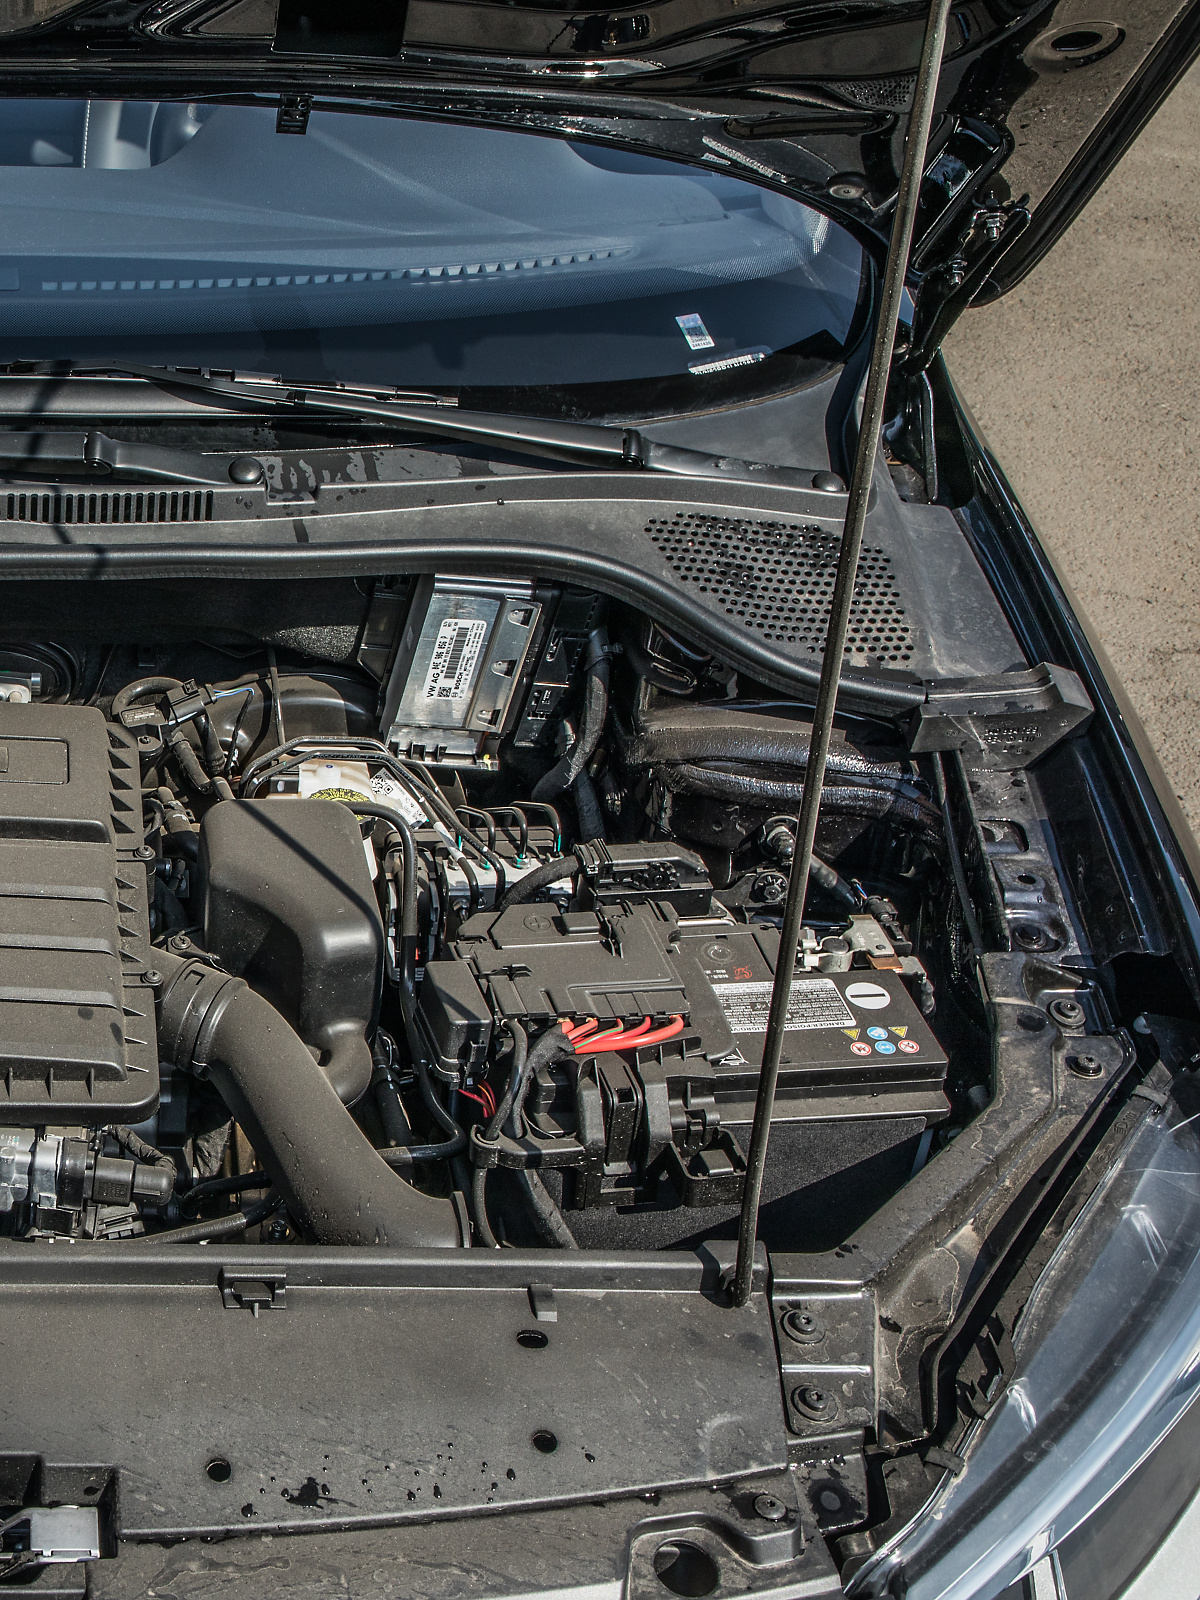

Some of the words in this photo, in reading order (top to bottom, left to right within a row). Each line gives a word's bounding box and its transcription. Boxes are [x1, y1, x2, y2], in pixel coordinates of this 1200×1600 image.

[431, 672, 440, 684] AG
[454, 672, 464, 690] BOSCH
[426, 685, 437, 698] VW
